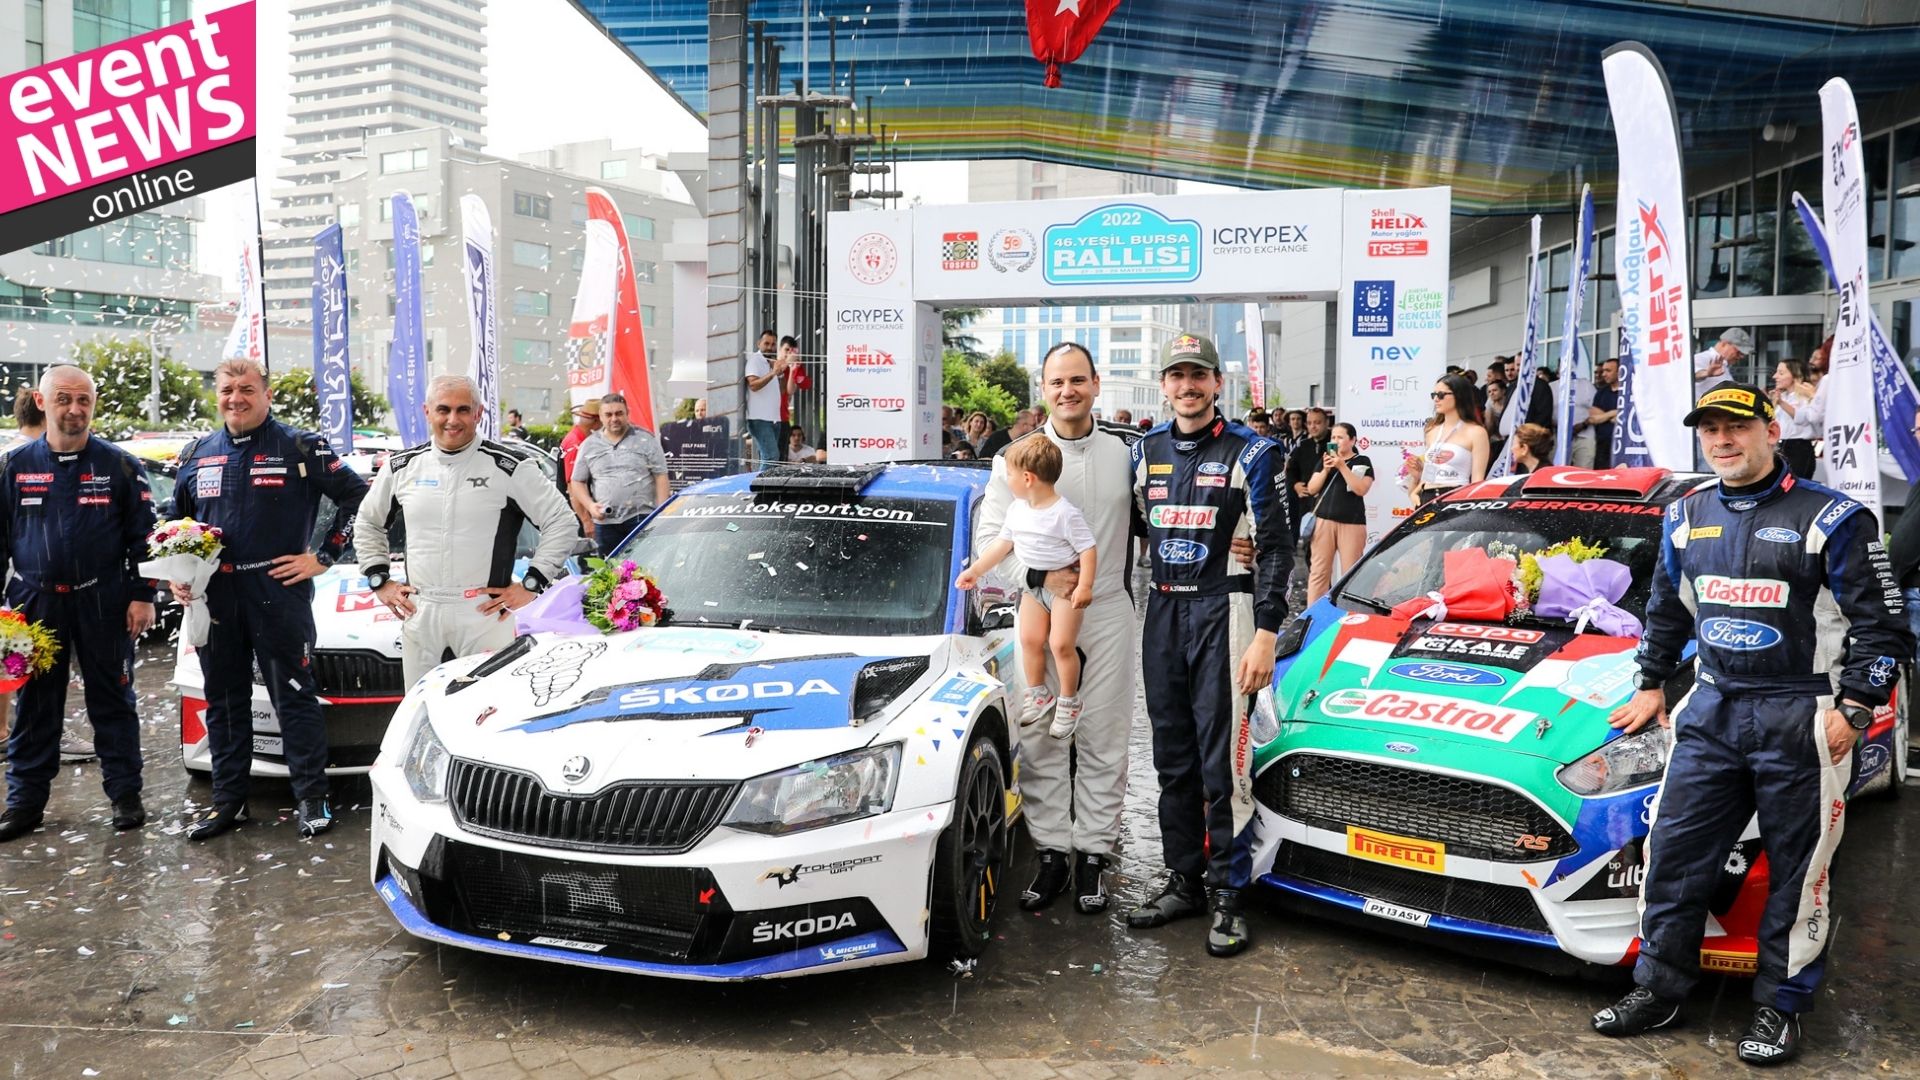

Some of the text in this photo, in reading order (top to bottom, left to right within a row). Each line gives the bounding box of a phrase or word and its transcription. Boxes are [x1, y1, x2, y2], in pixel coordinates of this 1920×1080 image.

[1102, 212, 1142, 227] 2022
[1371, 208, 1395, 217] Shell
[1371, 217, 1425, 229] HELIX
[1130, 233, 1190, 246] BURSA
[1213, 225, 1308, 245] ICRYPEX
[1395, 230, 1422, 238] yağları
[1213, 245, 1308, 255] CRYPTO EXCHANGE
[944, 261, 976, 269] TOSFED
[837, 309, 904, 323] ICRYPEX
[1357, 315, 1388, 323] BURSA
[846, 344, 867, 353] Shell
[846, 354, 894, 365] HELIX
[1361, 419, 1390, 428] ULUDAĞ
[683, 501, 914, 521] www.toksport.com
[1441, 500, 1665, 516] FORD PERFORMA
[1162, 507, 1213, 526] Castrol
[1414, 512, 1436, 526] 3
[1763, 528, 1792, 541] Ford
[1163, 542, 1195, 560] Ford
[1705, 579, 1782, 604] Castrol
[1439, 623, 1537, 640] copa
[1707, 622, 1761, 646] Ford
[1450, 639, 1530, 656] KALE
[1409, 664, 1478, 684] Ford
[619, 677, 840, 710] ŠKODA
[1364, 694, 1517, 735] Castrol
[1355, 833, 1435, 865] PIRELLI
[1514, 834, 1551, 850] RS
[1608, 861, 1621, 871] bp
[1371, 905, 1422, 922] PX 13 ASV
[752, 912, 857, 943] ŠKODA
[836, 943, 877, 955] MICHELIN
